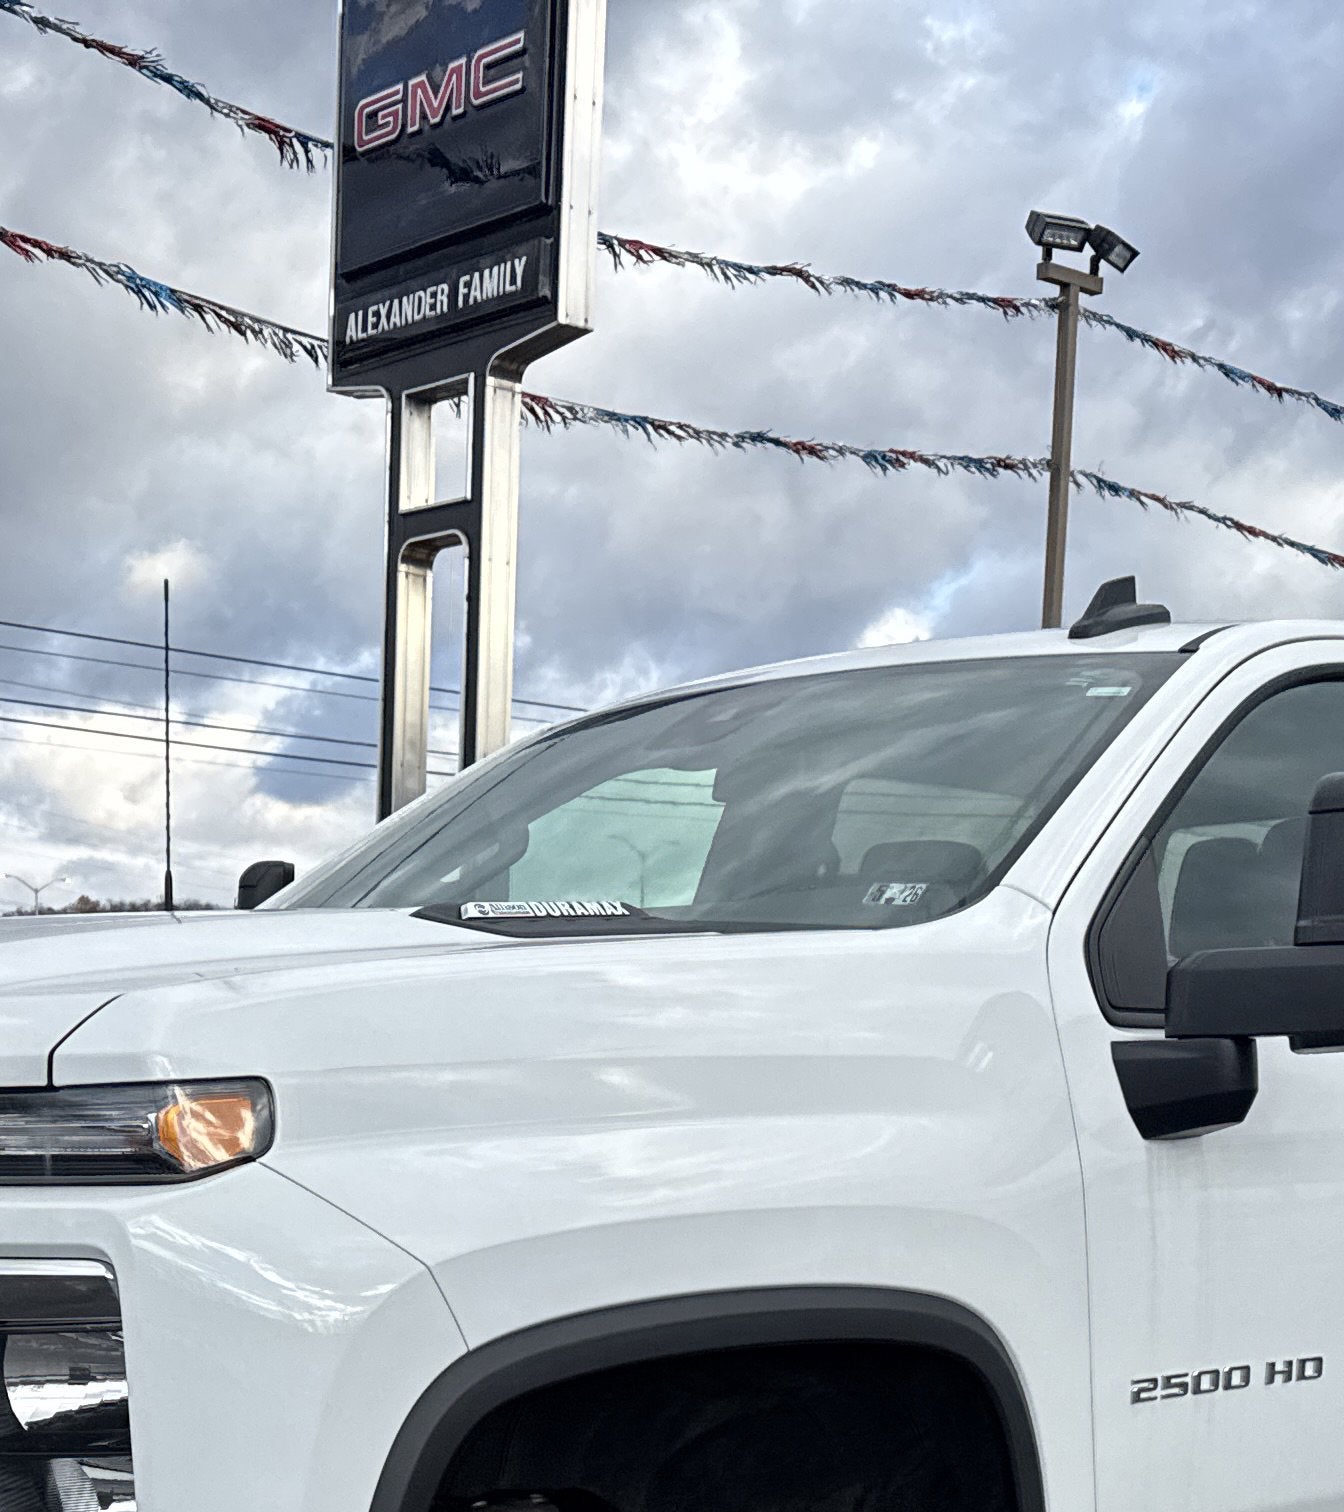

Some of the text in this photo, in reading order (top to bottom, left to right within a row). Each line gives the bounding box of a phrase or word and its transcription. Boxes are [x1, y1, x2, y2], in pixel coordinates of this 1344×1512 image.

[355, 30, 526, 151] GMC
[345, 256, 526, 344] ALEXANDER FAMILY
[529, 901, 631, 917] DURAMAX
[1130, 1356, 1323, 1405] 2500 HD
